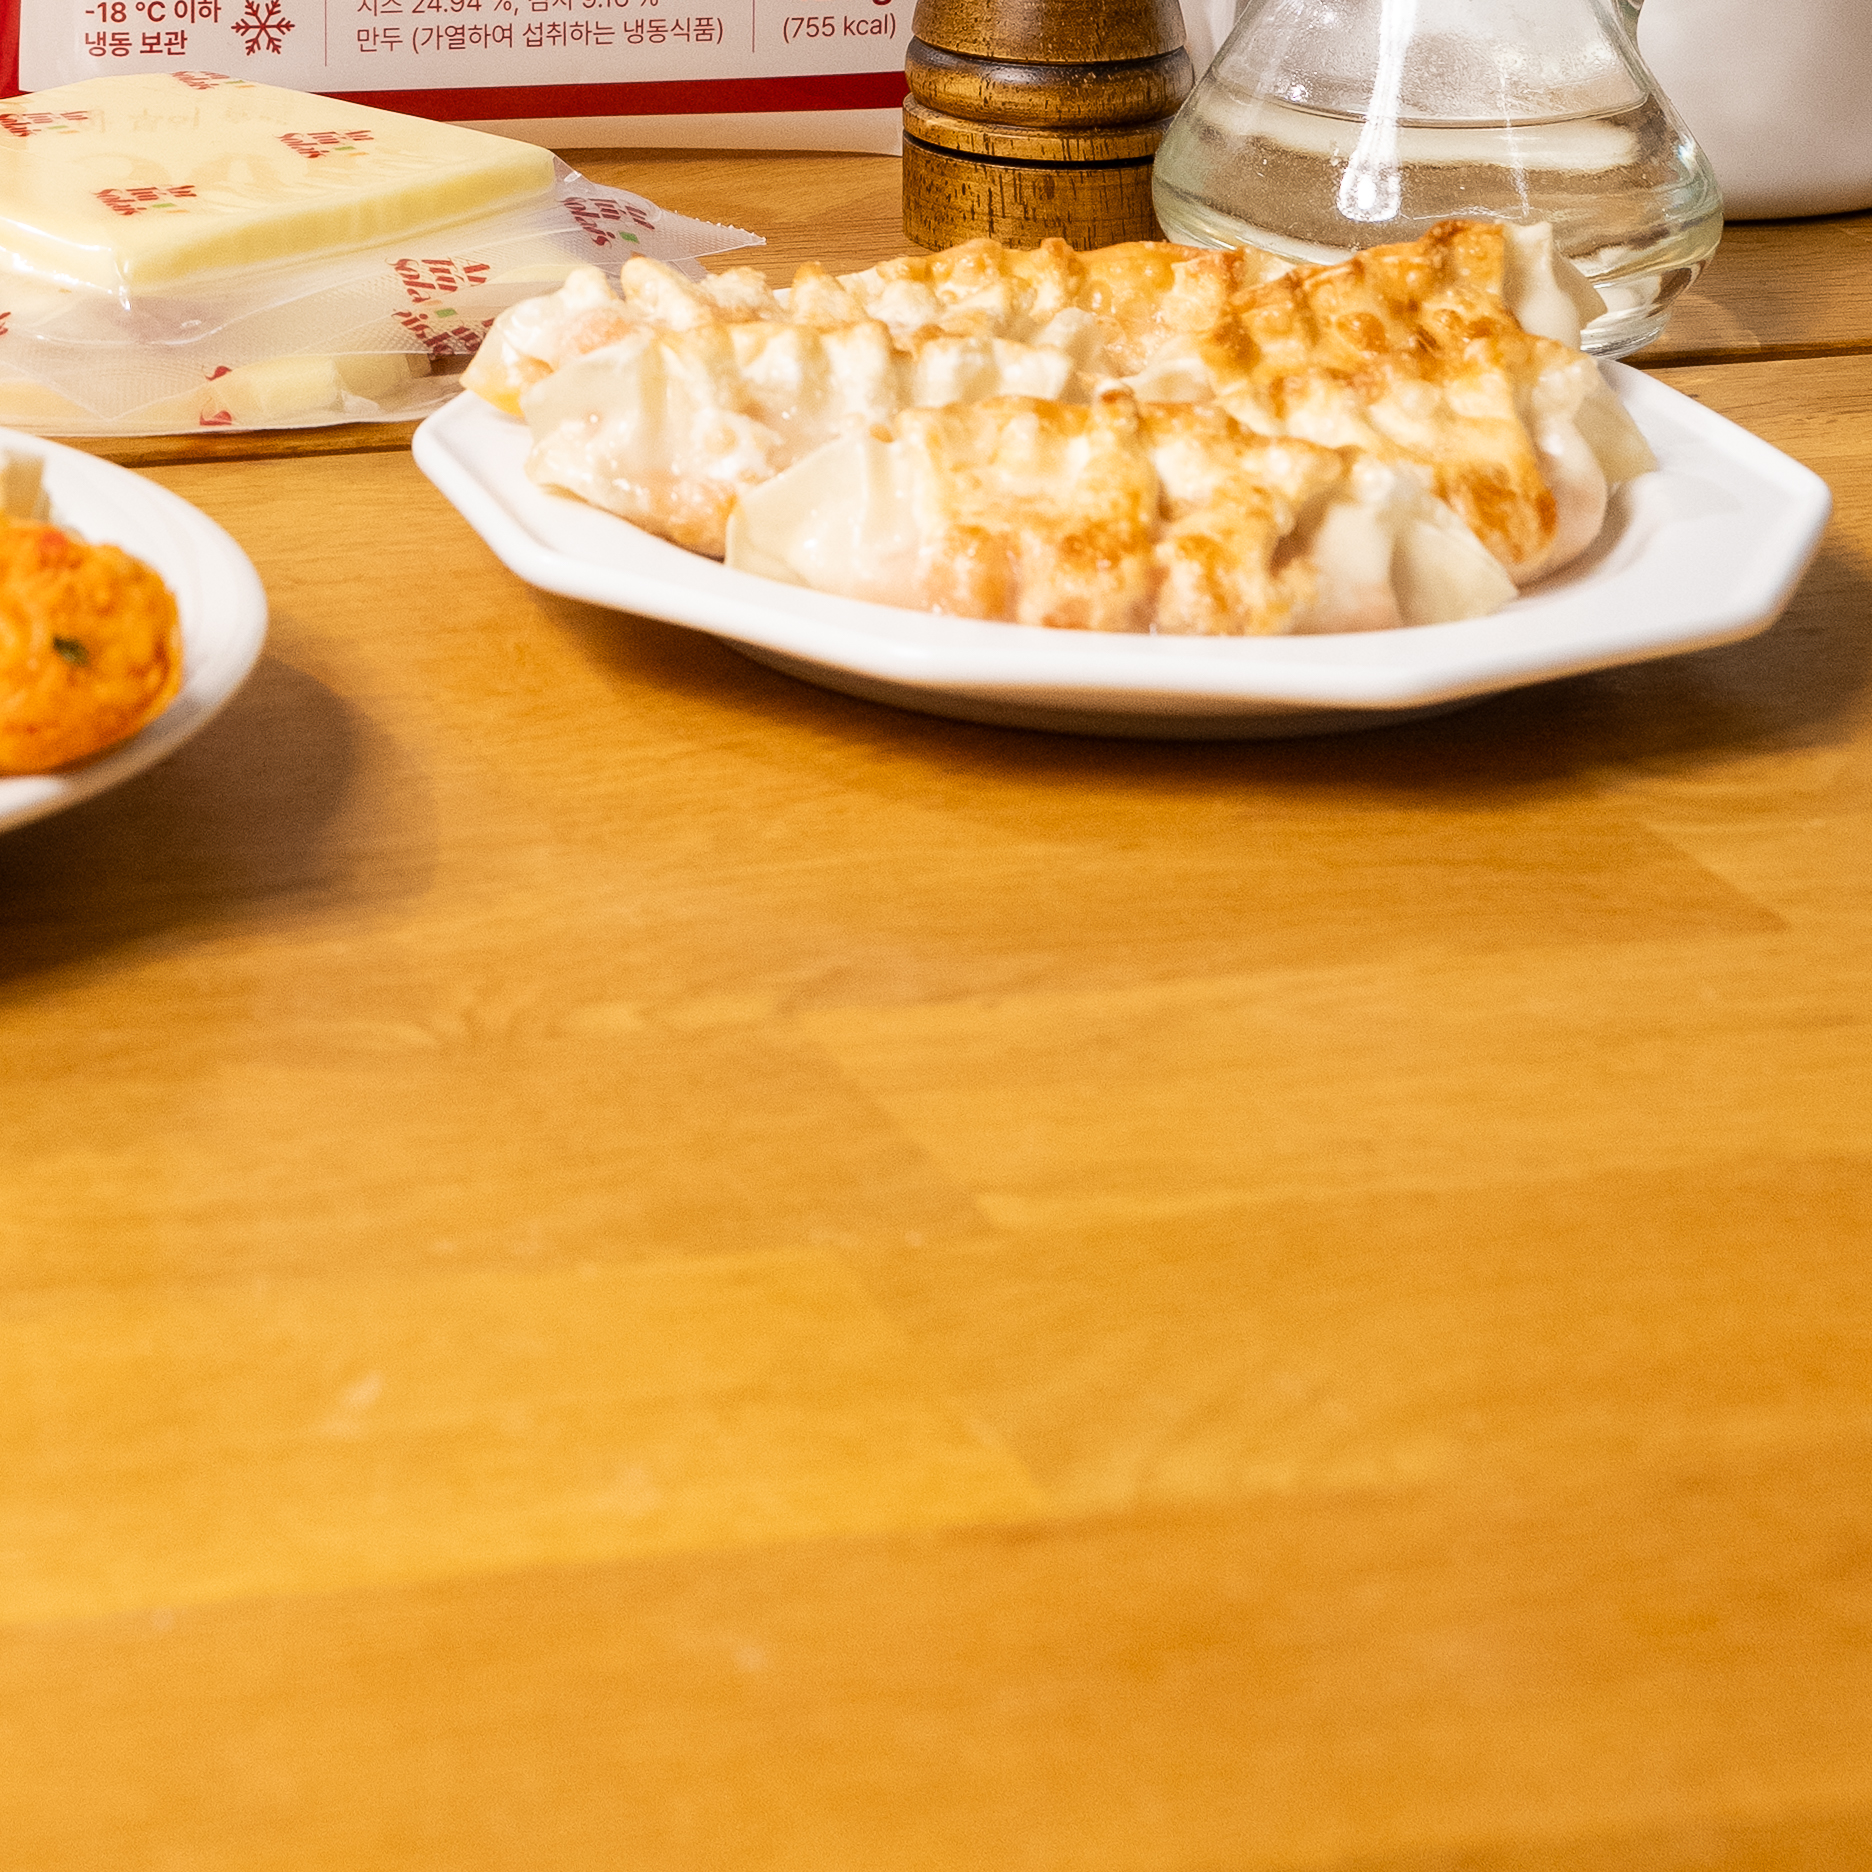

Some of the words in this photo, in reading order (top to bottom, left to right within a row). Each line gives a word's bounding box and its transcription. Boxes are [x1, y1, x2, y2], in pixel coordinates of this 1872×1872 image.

[85, 1, 127, 23] -18
[135, 0, 166, 23] °C
[357, 26, 404, 53] 만두
[412, 23, 514, 54] (가열하여
[522, 20, 616, 48] 섭취하는
[623, 17, 725, 45] 냉동식품)
[783, 15, 836, 44] (755
[843, 12, 896, 40] kcal)
[84, 31, 132, 57] 냉동
[139, 30, 188, 56] 보관
